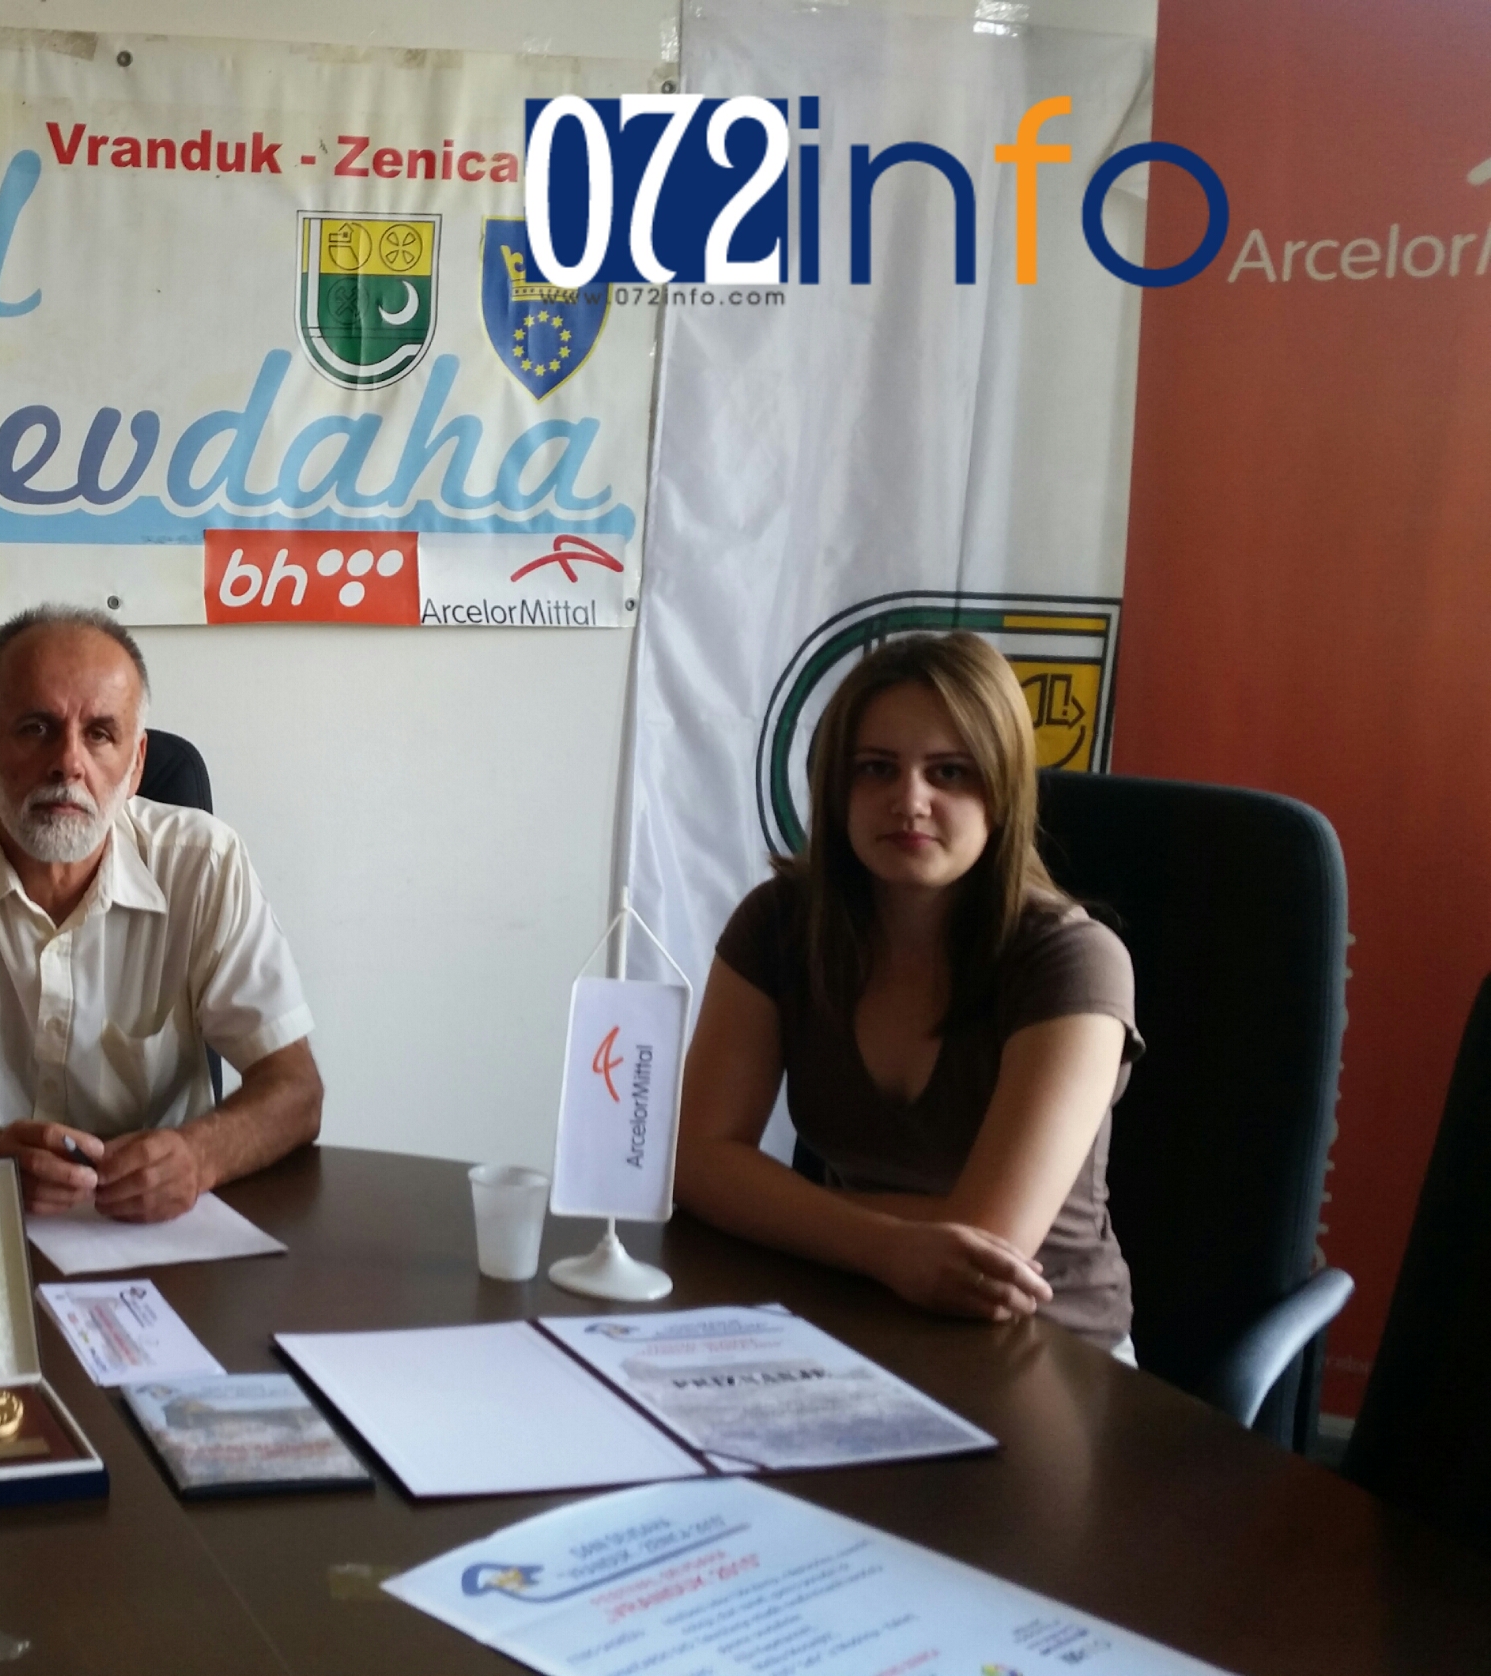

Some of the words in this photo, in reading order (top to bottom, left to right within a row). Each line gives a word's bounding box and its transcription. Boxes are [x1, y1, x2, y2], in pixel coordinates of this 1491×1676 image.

[46, 121, 283, 174] Vranduk
[300, 154, 317, 165] -
[334, 135, 519, 183] Zenica
[1227, 222, 1491, 283] Arcelor
[218, 548, 309, 608] bh
[421, 598, 598, 627] ArcelorMittal
[626, 1044, 653, 1169] ArcelorMittal
